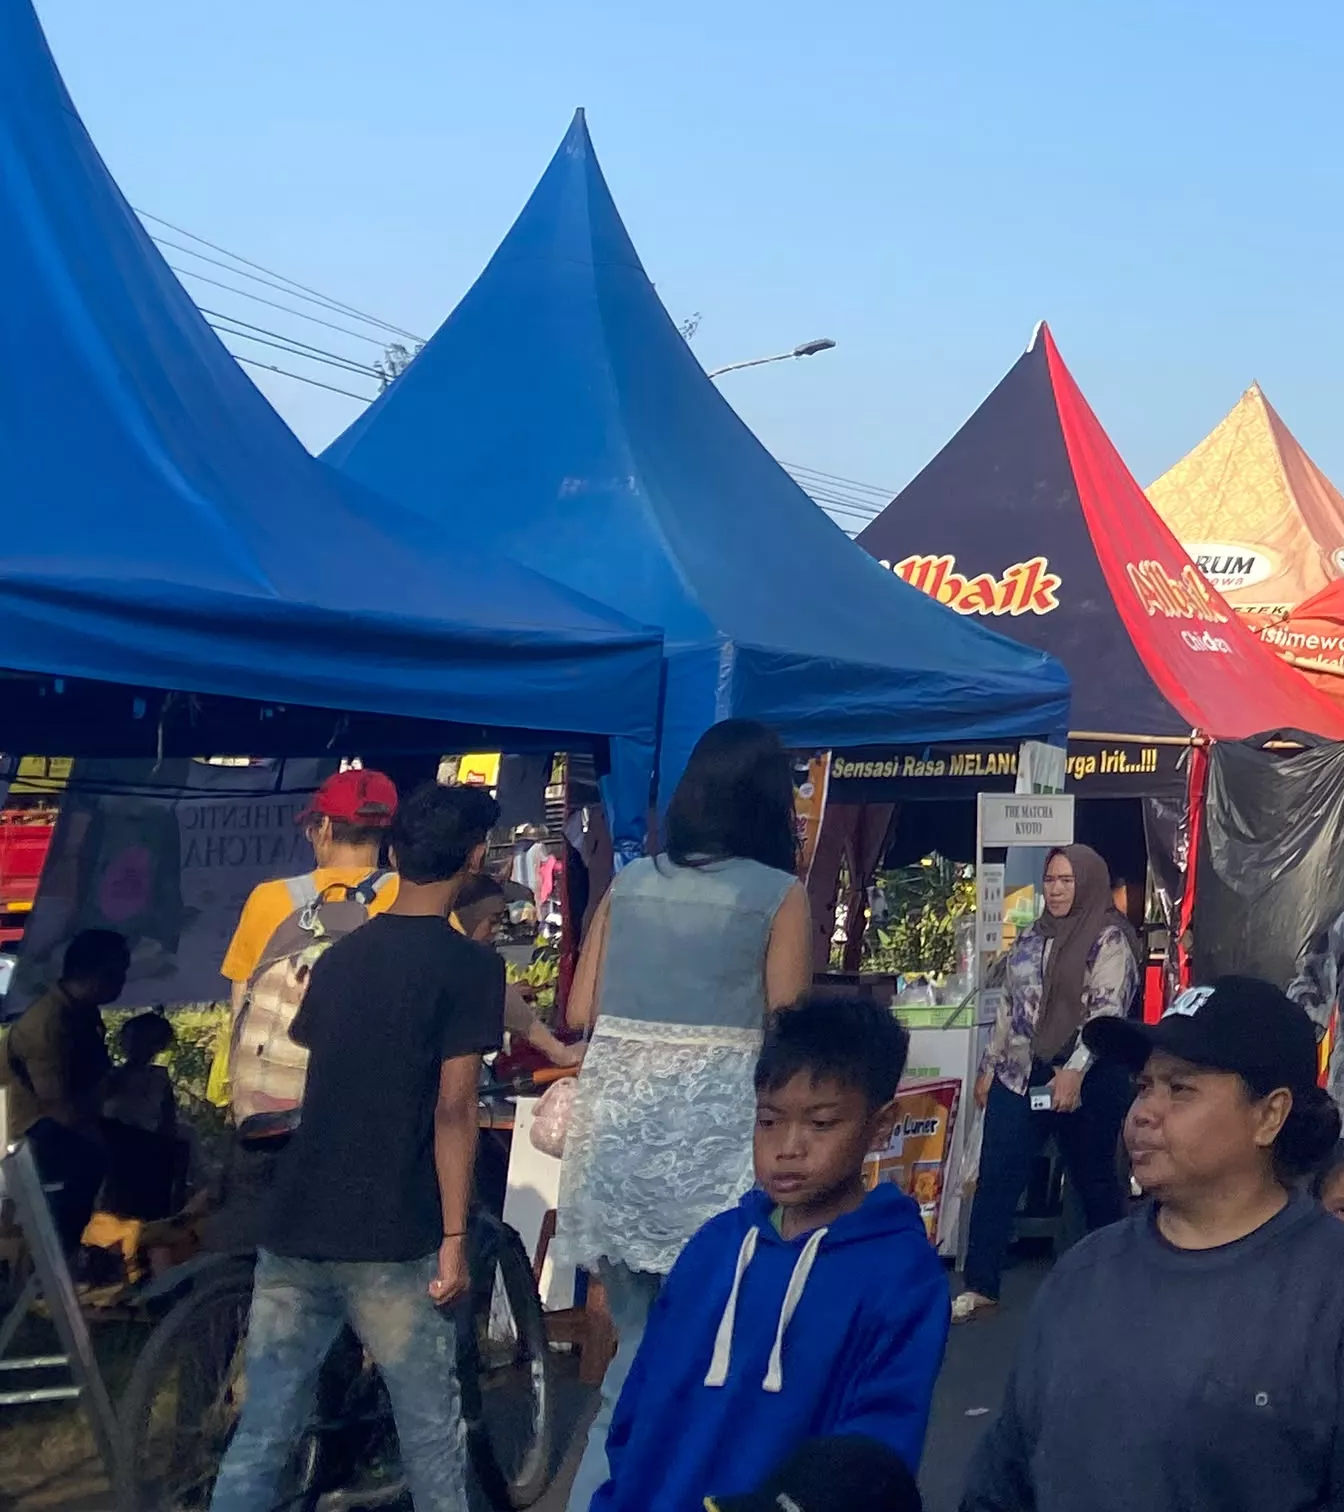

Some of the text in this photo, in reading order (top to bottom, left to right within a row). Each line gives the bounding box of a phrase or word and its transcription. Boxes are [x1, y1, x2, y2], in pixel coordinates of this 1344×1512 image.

[1195, 555, 1255, 575] RUM
[880, 554, 1062, 615] llbaik
[832, 755, 899, 778] Sensasi
[902, 755, 945, 777] Rasa
[1065, 755, 1096, 780] rga
[1004, 805, 1054, 819] THE MATCHA
[1015, 822, 1043, 835] KYOTO
